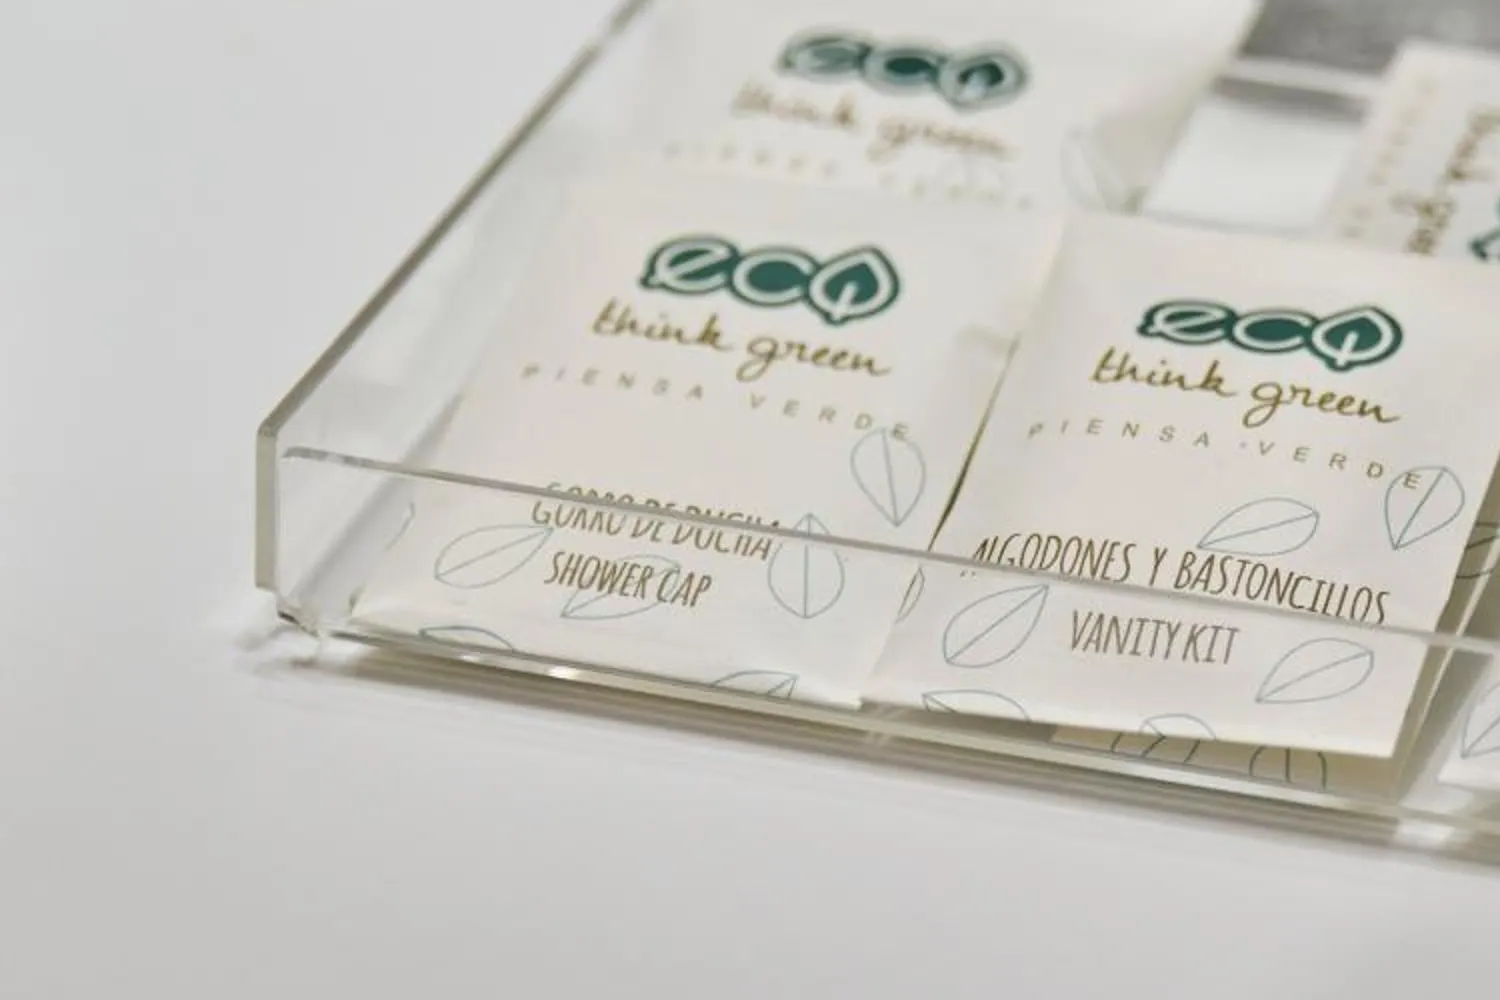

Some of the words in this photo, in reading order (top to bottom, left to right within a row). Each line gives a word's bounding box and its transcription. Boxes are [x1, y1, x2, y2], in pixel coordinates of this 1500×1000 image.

[639, 234, 901, 326] eco
[591, 297, 734, 352] think
[736, 332, 892, 383] green
[1136, 298, 1404, 372] eco
[520, 361, 705, 400] PIENSA
[749, 392, 910, 442] VERDE
[1089, 346, 1237, 399] think
[1242, 379, 1401, 428] green
[1027, 417, 1211, 449] PIENSA
[1257, 440, 1422, 491] VERDE
[543, 550, 655, 600] SHOWER
[656, 566, 713, 609] CAP
[1149, 546, 1168, 587] Y
[1173, 550, 1391, 625] BASTONCILLOS
[1070, 609, 1182, 660] VANITY
[1181, 622, 1242, 666] KIT
